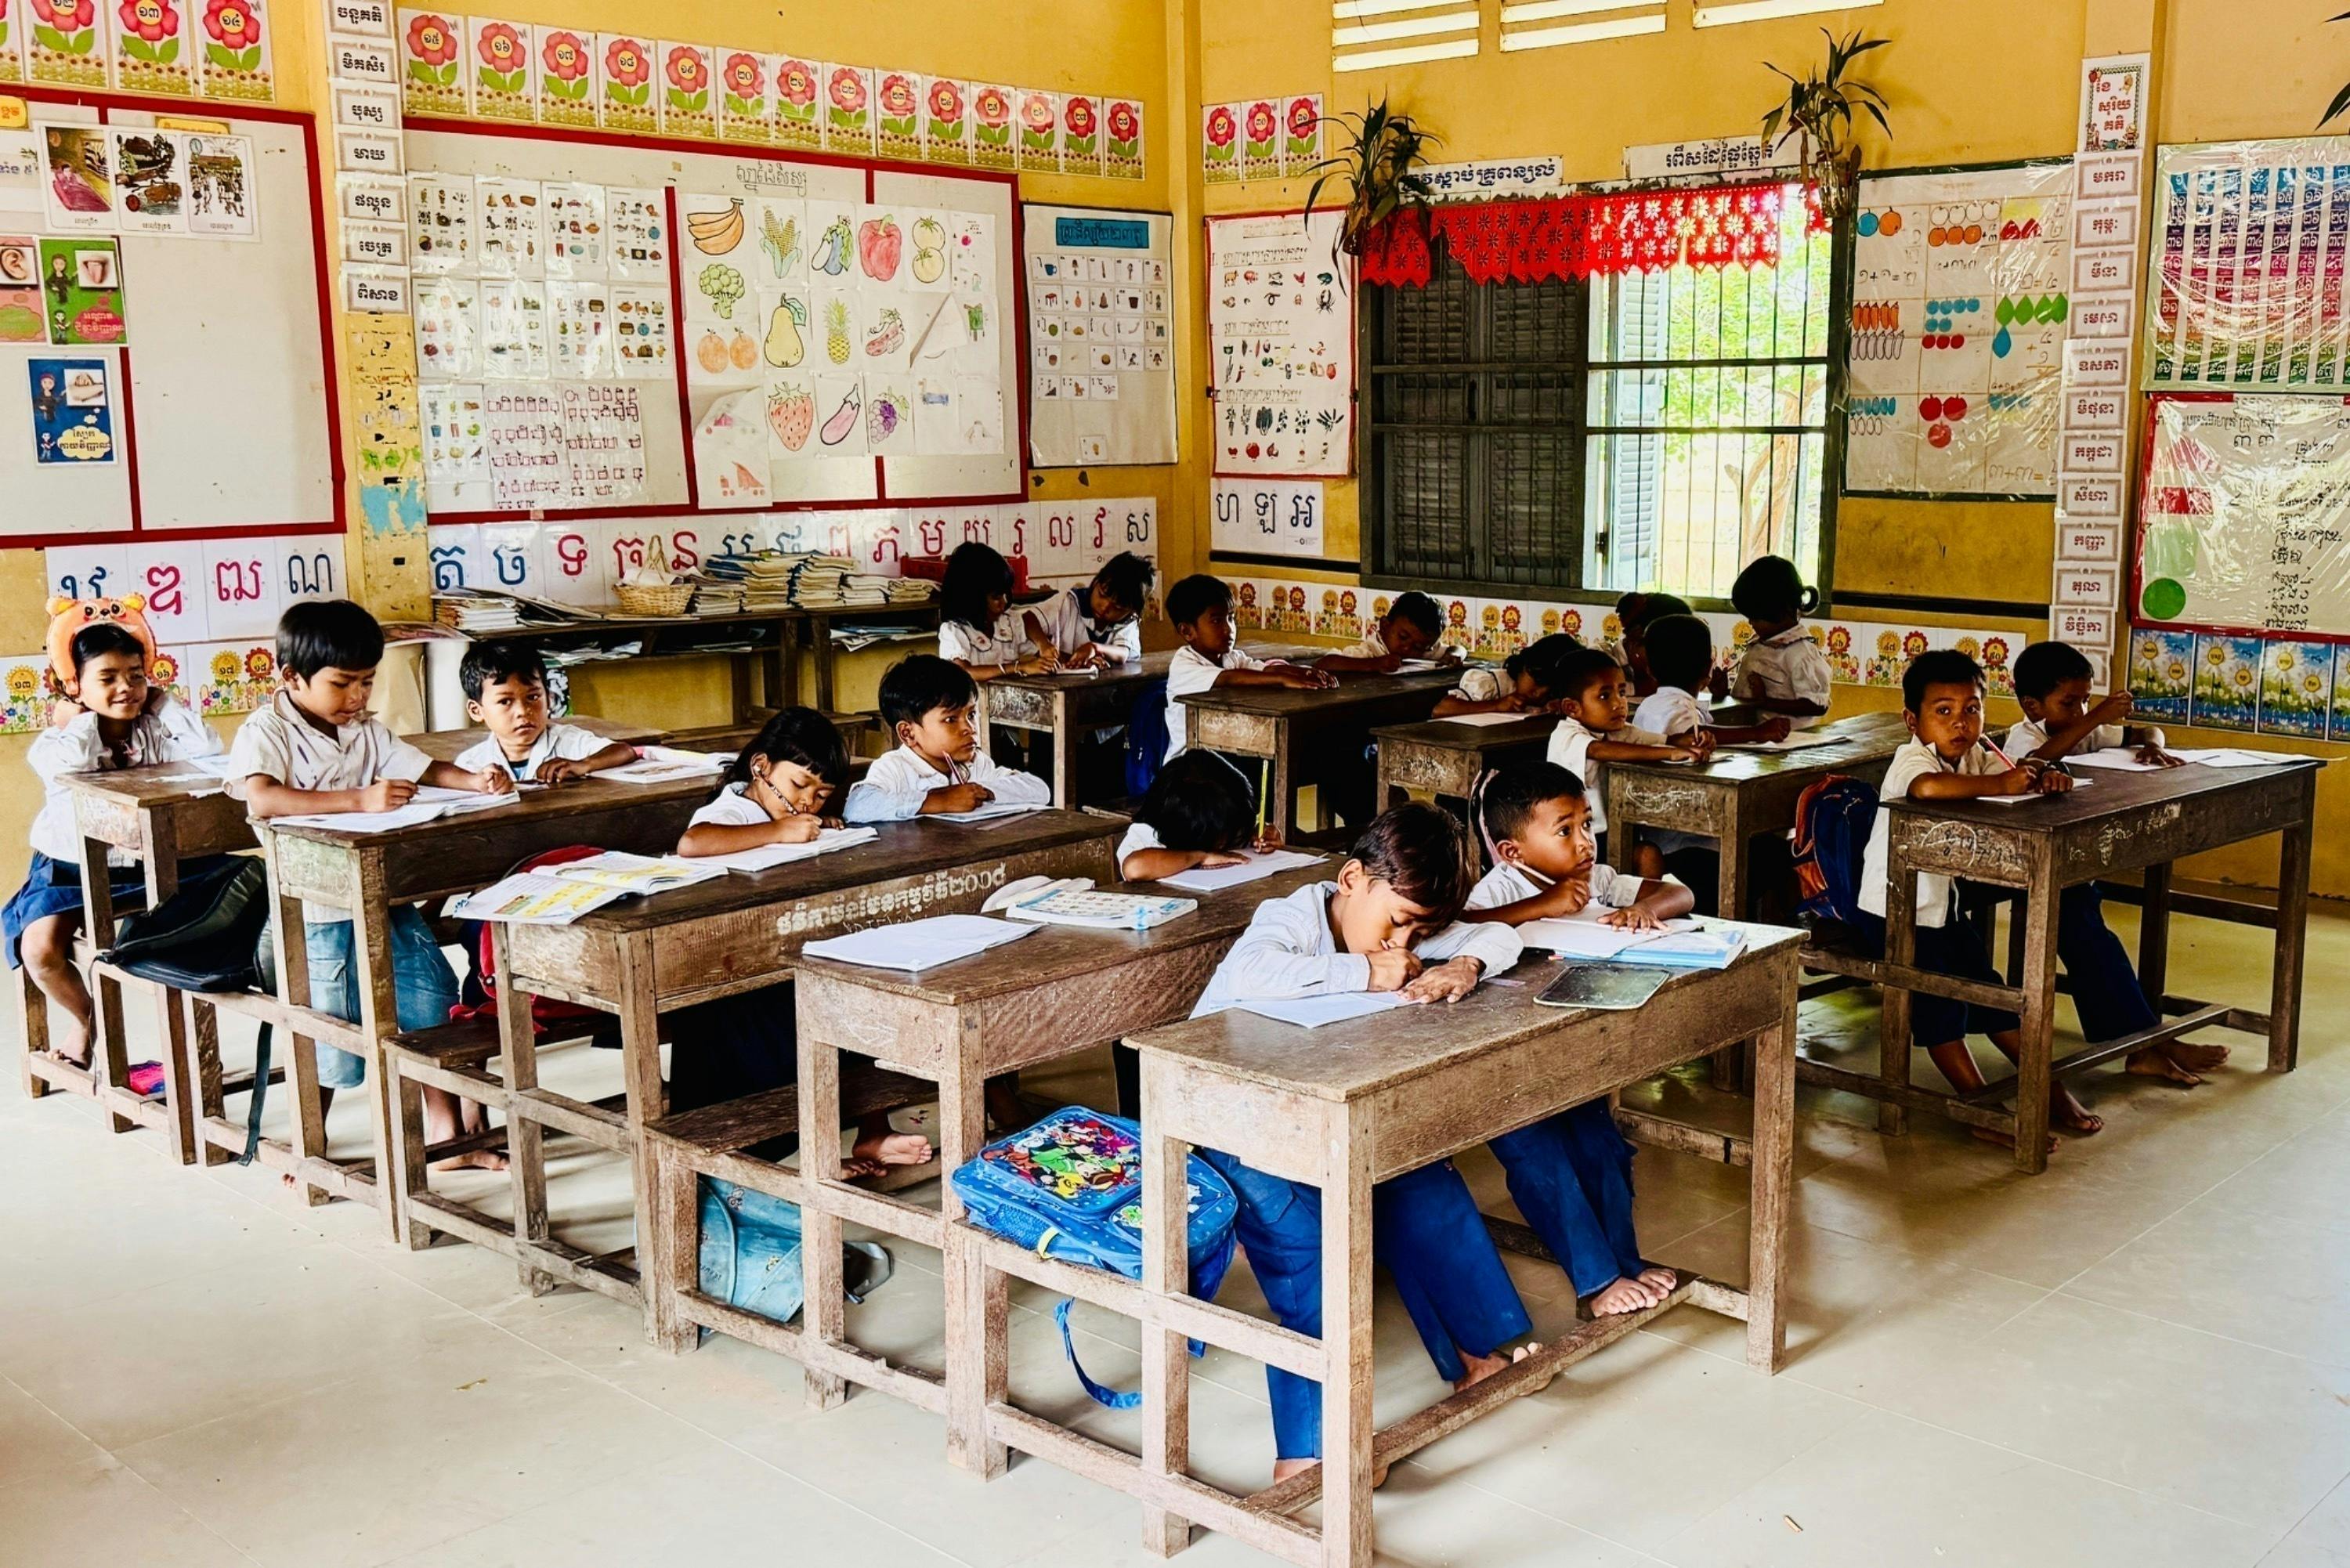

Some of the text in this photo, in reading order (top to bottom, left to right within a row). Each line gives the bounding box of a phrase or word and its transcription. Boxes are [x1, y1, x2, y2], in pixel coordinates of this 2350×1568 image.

[139, 6, 159, 18] ១៣
[222, 13, 241, 27] ១៤
[494, 40, 511, 52] ១៦
[738, 70, 753, 81] ២០
[790, 77, 803, 88] ២១
[2104, 114, 2124, 131] គតិ
[2092, 170, 2125, 183] មករា
[359, 240, 392, 257] ចេត្រ
[2091, 262, 2117, 279] មីនា
[357, 283, 399, 301] ពិសាខ
[2083, 311, 2118, 325] មេសា
[2078, 359, 2120, 372] ឧសភា
[2077, 400, 2114, 420] មិថុនា
[2074, 445, 2113, 461] កក្កដា
[2073, 486, 2108, 503] សីហា
[1216, 492, 1316, 533] ហ ឡ អ
[430, 545, 466, 590] ត
[558, 534, 588, 576] ទ
[919, 520, 945, 555] ម
[1049, 515, 1074, 547] ល
[1094, 507, 1107, 548] វ
[1126, 512, 1150, 543] ស
[2073, 534, 2106, 551] កញ្ញា
[287, 553, 333, 594] ណ
[2071, 579, 2102, 594] តុលា
[2064, 617, 2102, 638] វិច្ឆិកា
